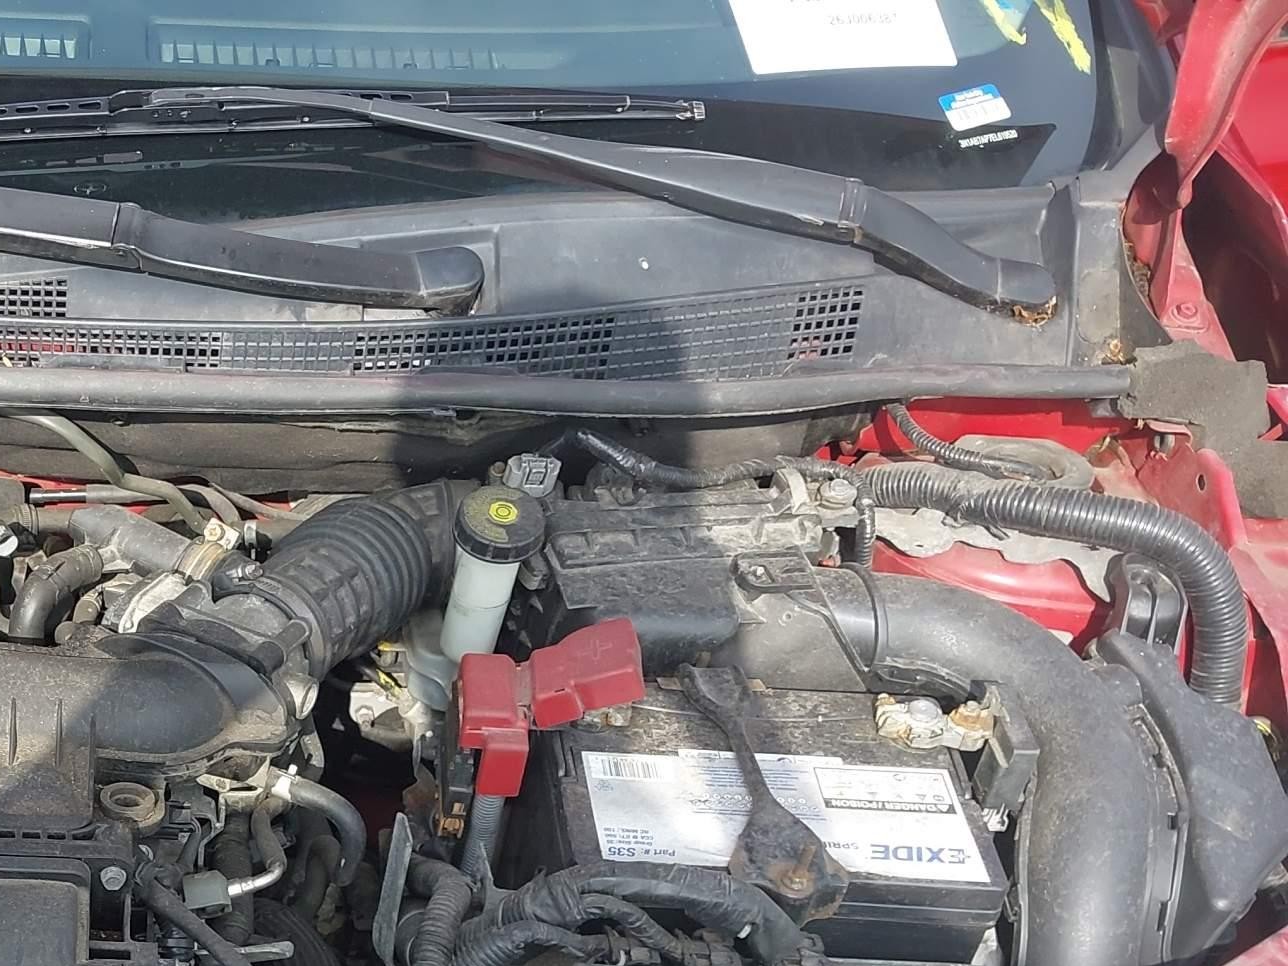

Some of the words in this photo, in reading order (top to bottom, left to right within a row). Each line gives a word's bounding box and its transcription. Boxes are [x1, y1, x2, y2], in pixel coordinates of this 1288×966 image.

[832, 799, 877, 809] POISON
[885, 801, 937, 812] DANGER
[608, 846, 636, 857] S35
[654, 848, 675, 857] Part
[870, 843, 968, 864] EXIDE
